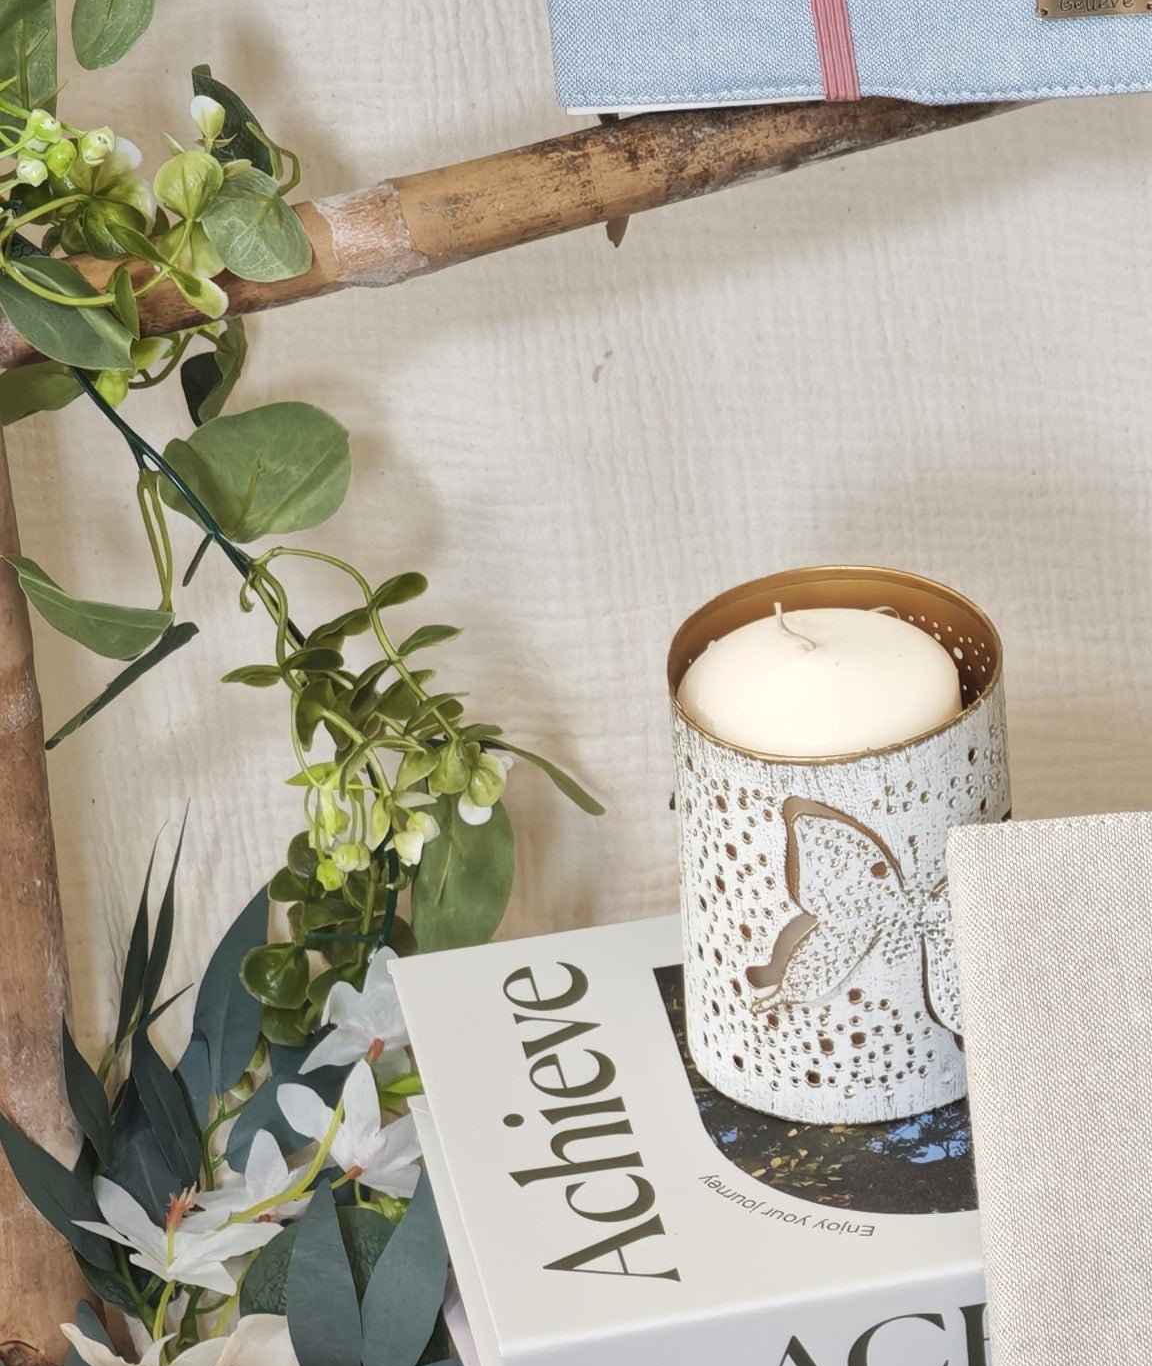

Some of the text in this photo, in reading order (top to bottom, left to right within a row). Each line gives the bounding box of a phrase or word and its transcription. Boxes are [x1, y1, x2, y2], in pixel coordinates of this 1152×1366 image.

[501, 960, 682, 1283] Achieve
[698, 1174, 876, 1237] Enjoy your journey
